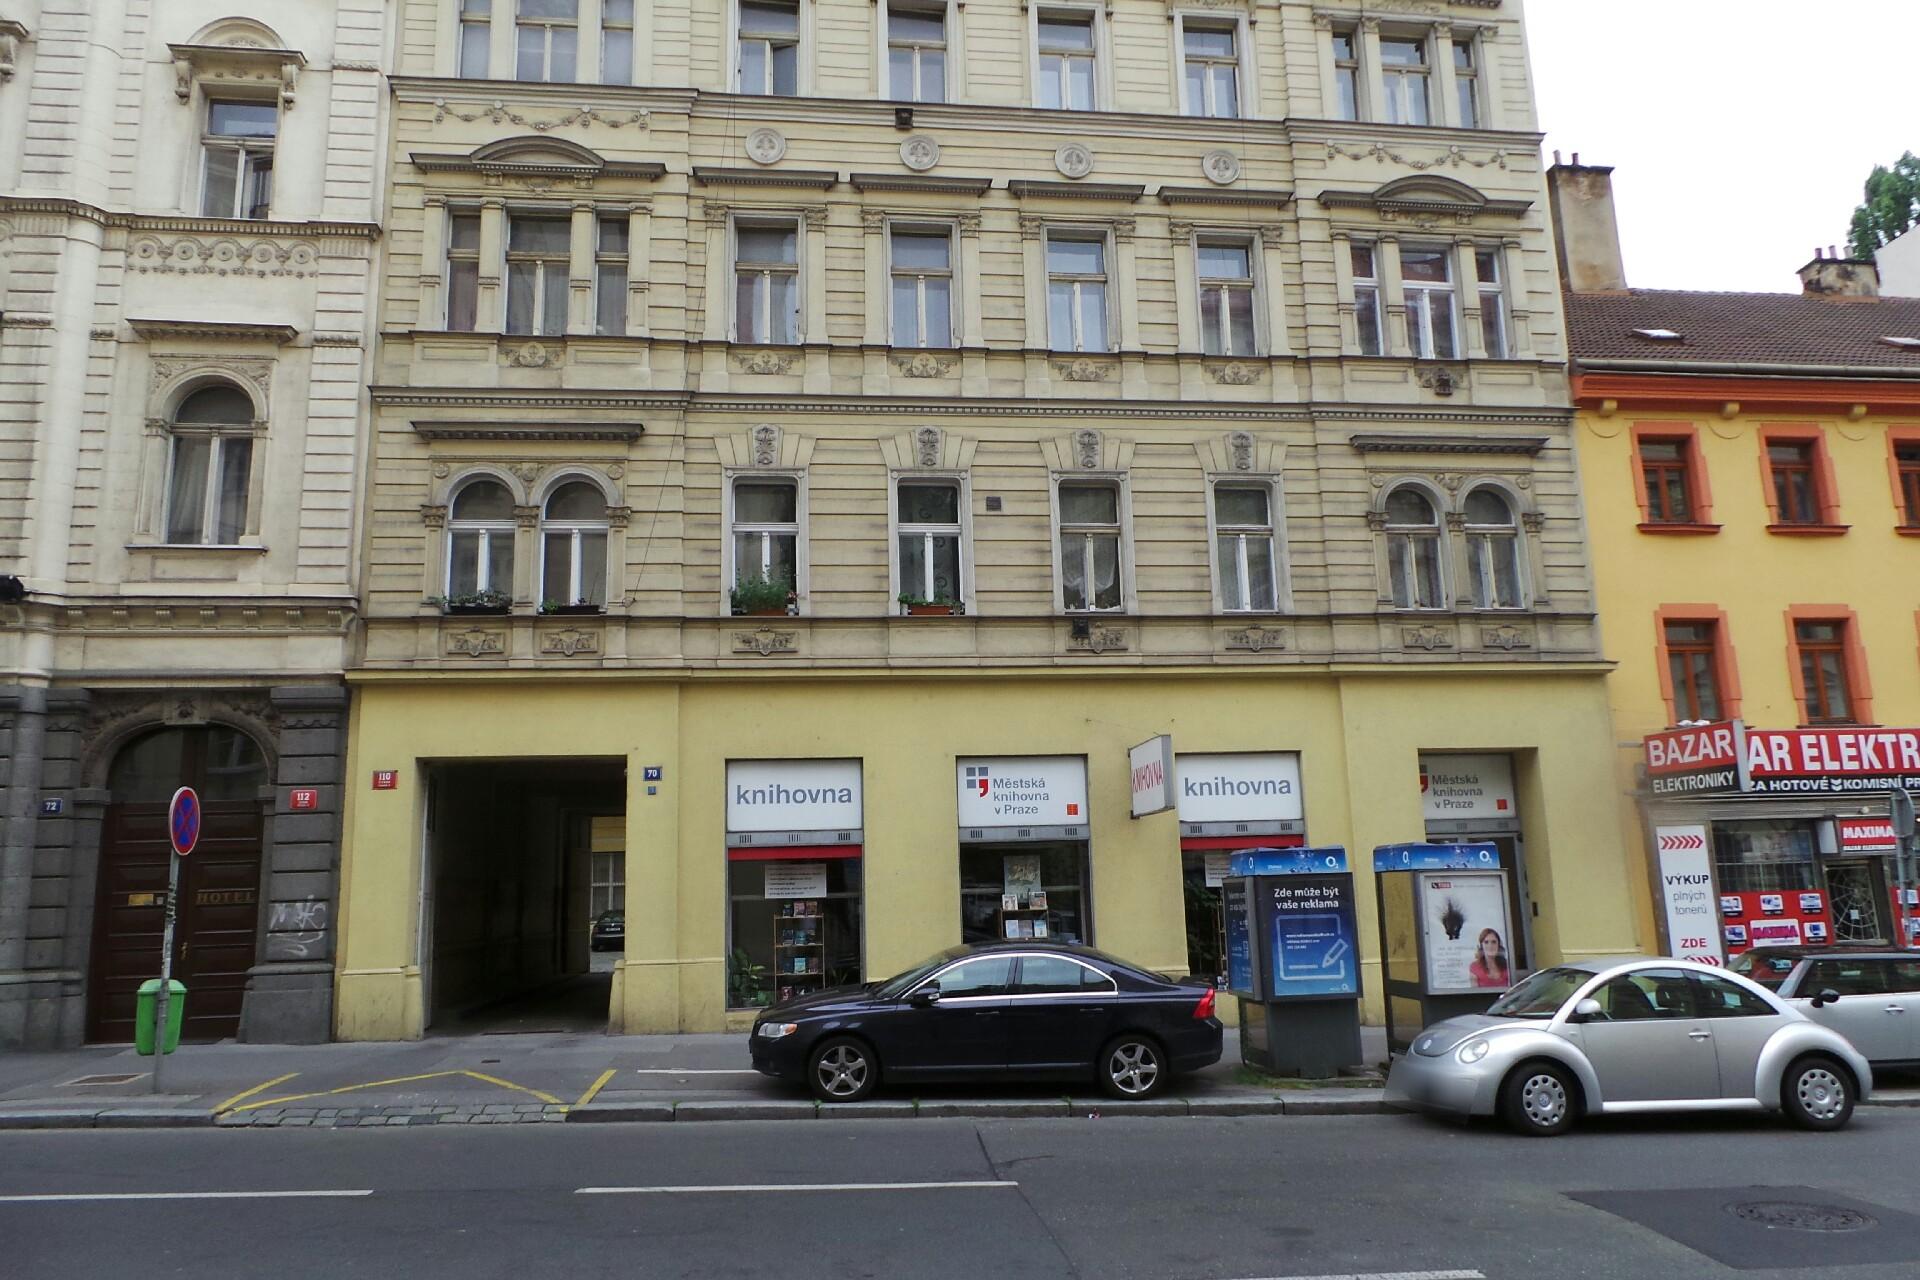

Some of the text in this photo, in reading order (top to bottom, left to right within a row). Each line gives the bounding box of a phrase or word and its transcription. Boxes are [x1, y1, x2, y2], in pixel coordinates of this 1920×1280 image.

[1648, 729, 1735, 767] BAZAR
[1749, 733, 1920, 771] AR ELEKTR
[378, 772, 391, 781] 110
[647, 769, 658, 778] 70
[1132, 759, 1164, 793] KNIHOVNA
[1432, 774, 1479, 785] Městská
[993, 777, 1046, 789] Městská
[1185, 776, 1291, 797] knihovna
[1653, 770, 1735, 793] ELEKTRONIKY
[1769, 775, 1829, 791] HOTOVÉ
[1843, 774, 1903, 790] KOMISNÍ
[296, 792, 310, 801] 112
[736, 784, 852, 805] knihovna
[993, 791, 1049, 802] knihovna
[1433, 787, 1483, 797] knihovna
[45, 801, 57, 811] 72
[994, 804, 1039, 815] v Praze
[1434, 799, 1474, 809] v Praze
[1842, 825, 1895, 839] MAXIMA
[1665, 873, 1709, 885] VÝKUP
[1274, 886, 1340, 899] Zde může být
[1673, 889, 1706, 903] plných
[1276, 899, 1339, 909] vaše reklama
[1675, 904, 1707, 915] tonerů
[1681, 937, 1707, 949] ZDE
